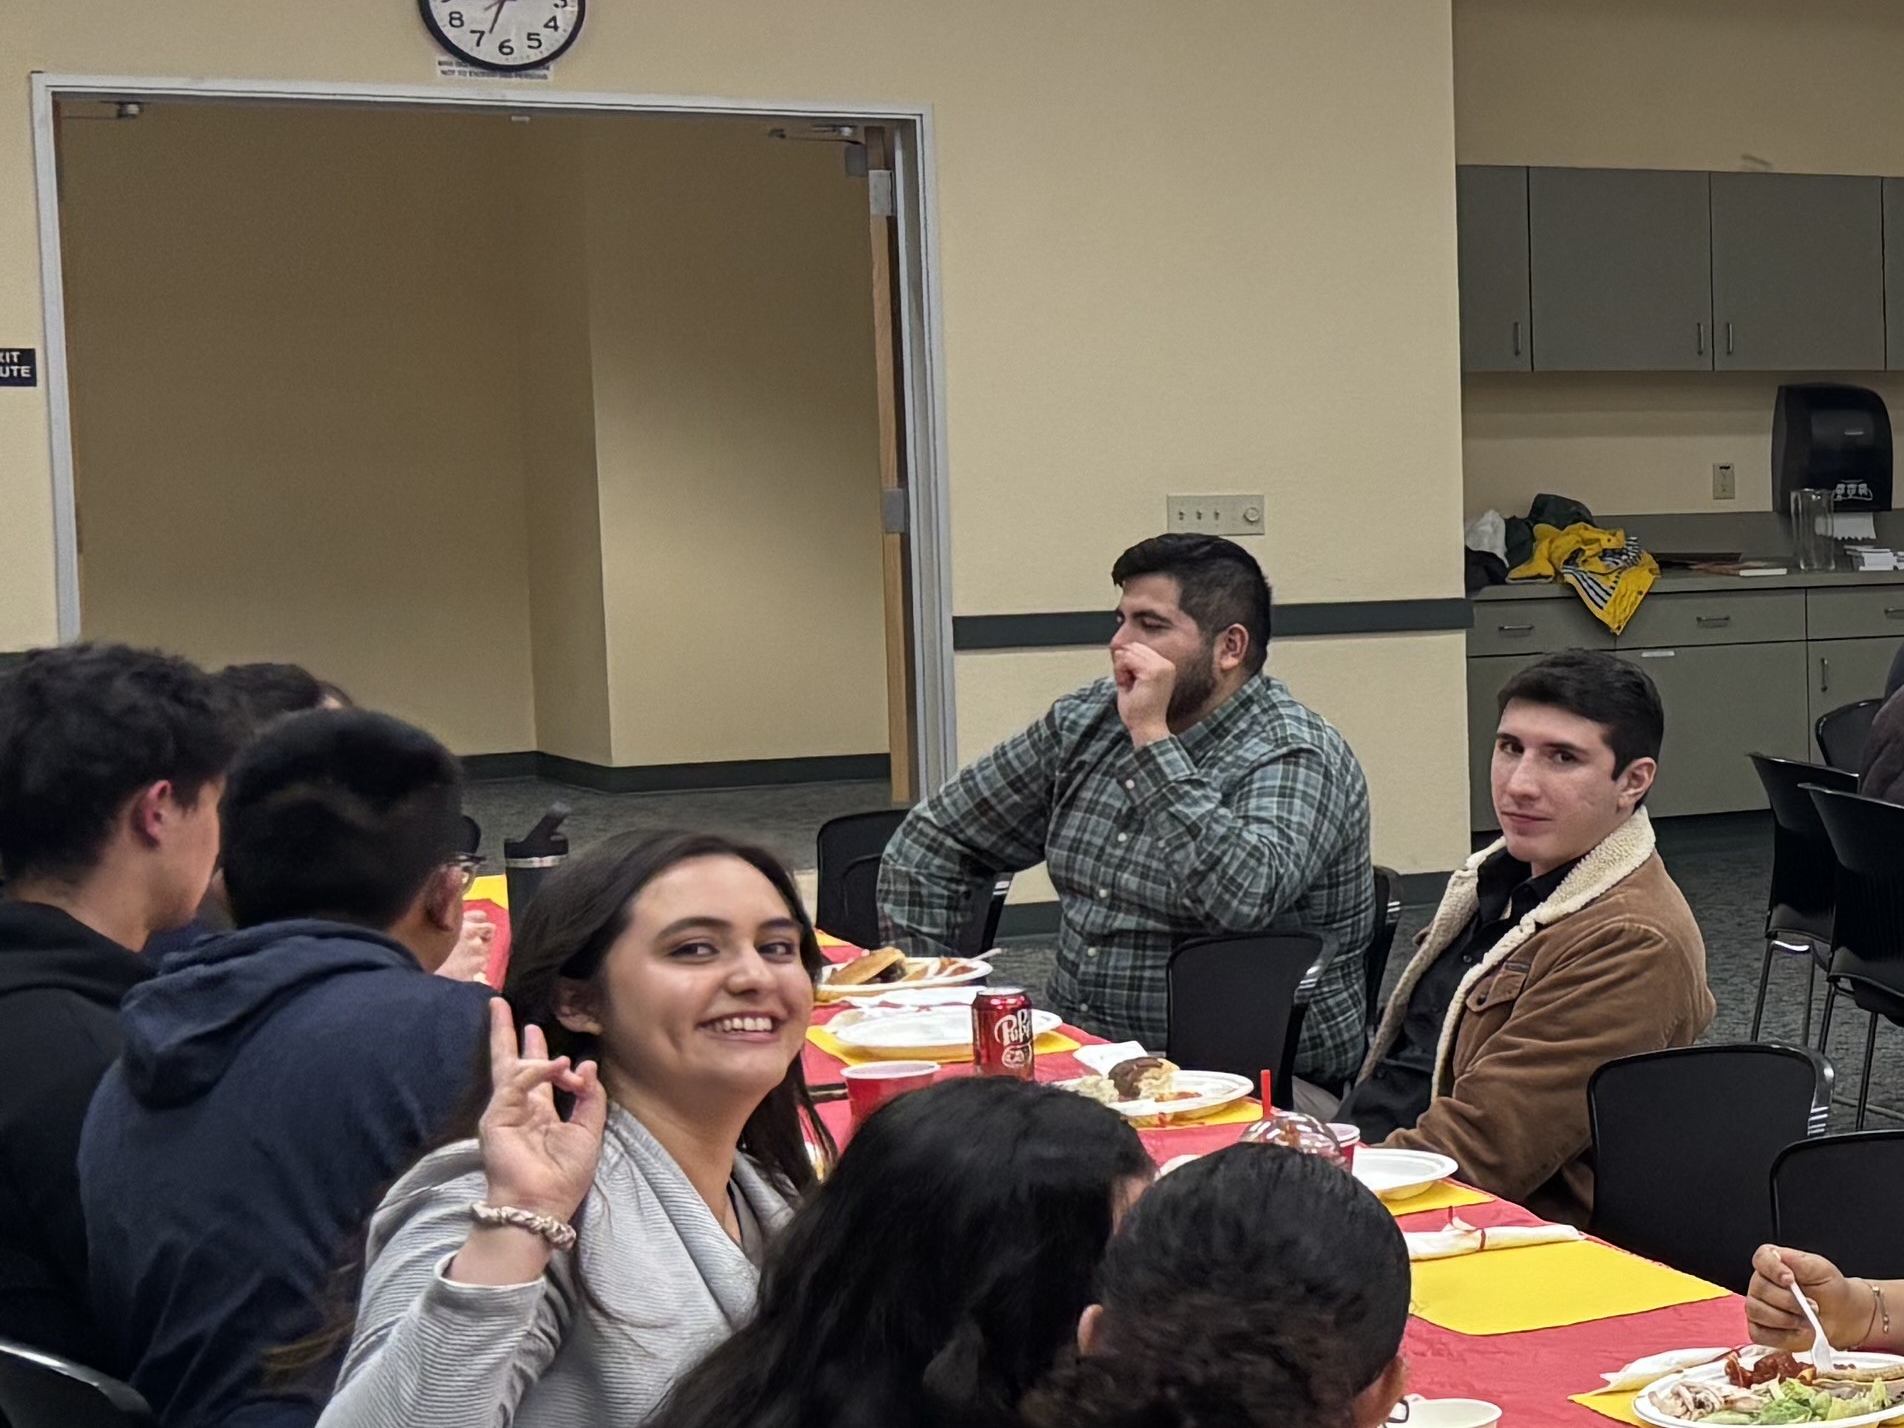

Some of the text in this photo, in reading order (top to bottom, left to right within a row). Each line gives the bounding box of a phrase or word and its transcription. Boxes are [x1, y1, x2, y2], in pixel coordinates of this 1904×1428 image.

[448, 10, 465, 28] 8
[543, 14, 560, 32] 4
[469, 29, 486, 47] 7
[498, 38, 515, 56] 6
[526, 32, 543, 50] 5
